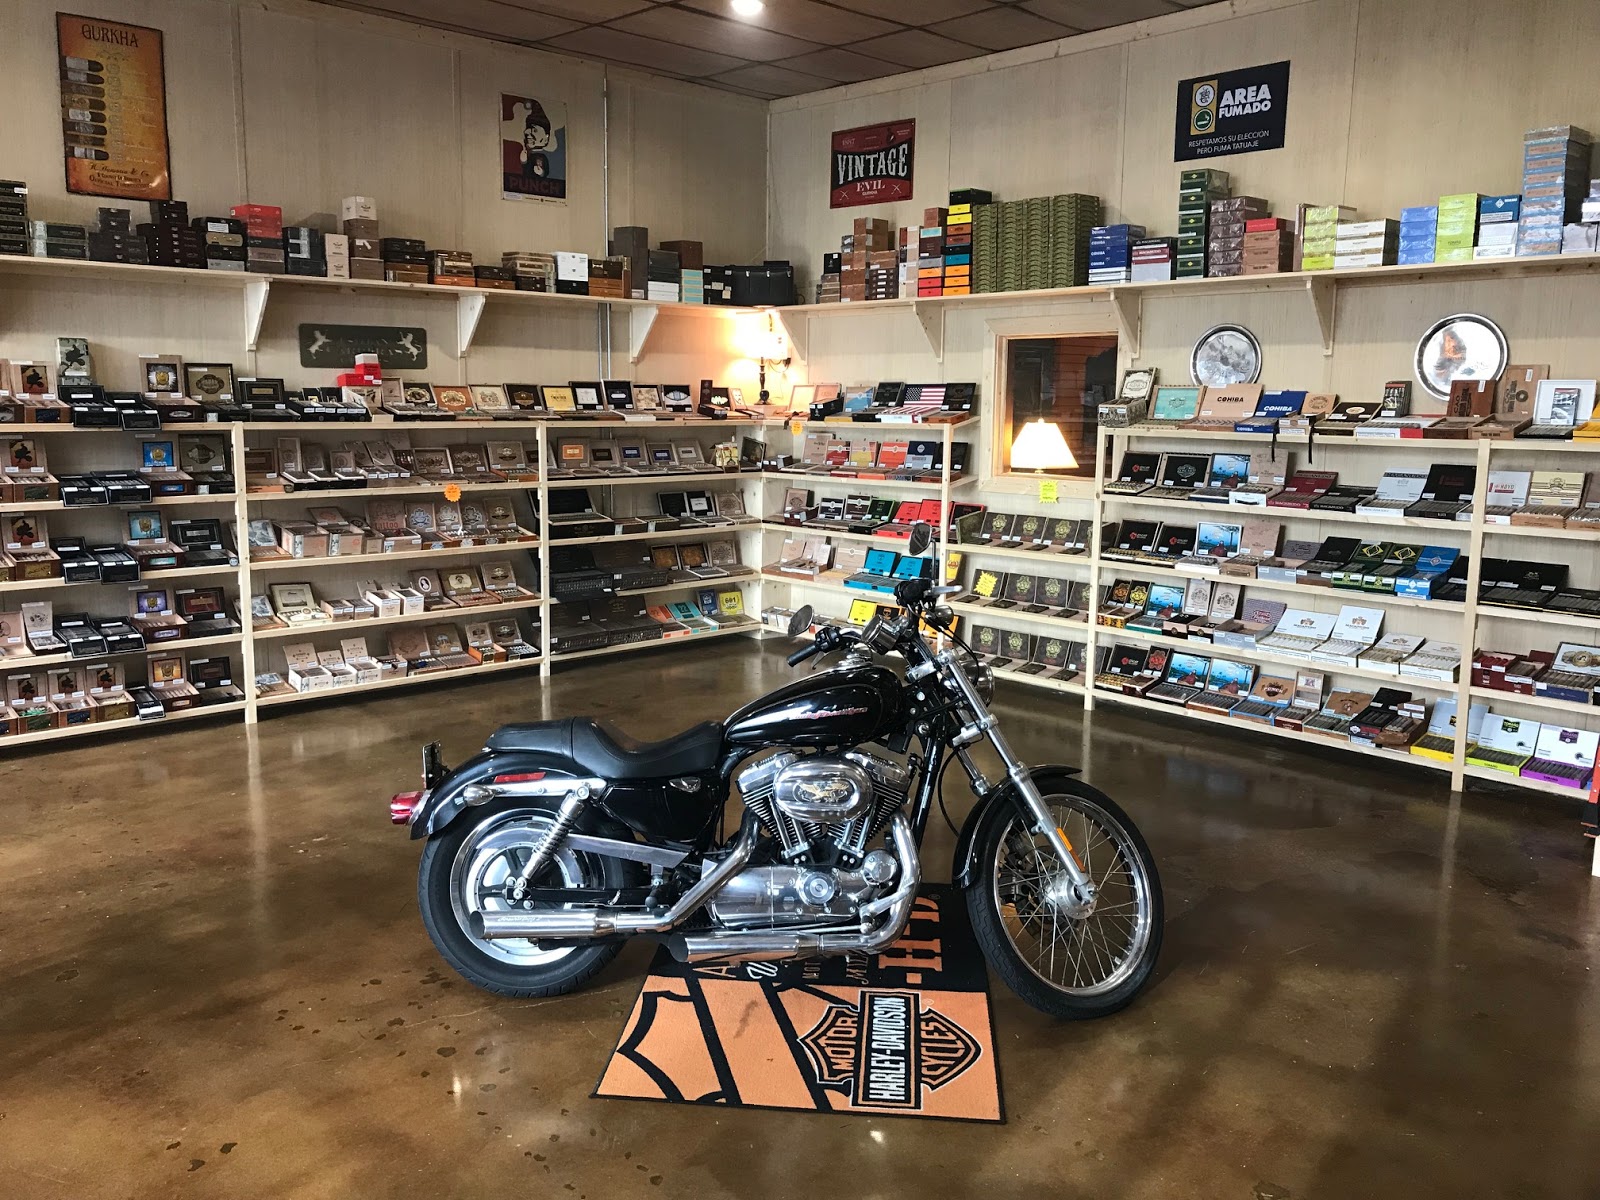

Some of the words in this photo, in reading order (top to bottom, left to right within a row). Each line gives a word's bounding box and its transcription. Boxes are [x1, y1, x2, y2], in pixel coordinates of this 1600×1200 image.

[1219, 83, 1272, 108] AREA
[1218, 100, 1272, 119] FUMADO
[1188, 135, 1227, 148] RESPETAMOS
[1227, 134, 1237, 142] SU
[1237, 129, 1270, 141] ELECCIÓN
[1196, 146, 1213, 154] PERO
[1213, 143, 1232, 151] FUMA
[1232, 139, 1259, 149] TATUAJE
[836, 143, 908, 185] VINTAGE
[509, 177, 561, 195] PUNCH
[856, 179, 887, 192] EVIL
[724, 597, 737, 605] 601
[817, 1016, 859, 1071] MOTOR
[868, 996, 907, 1101] HARLEY-DAVIDSON
[920, 1021, 966, 1076] CYCLES
